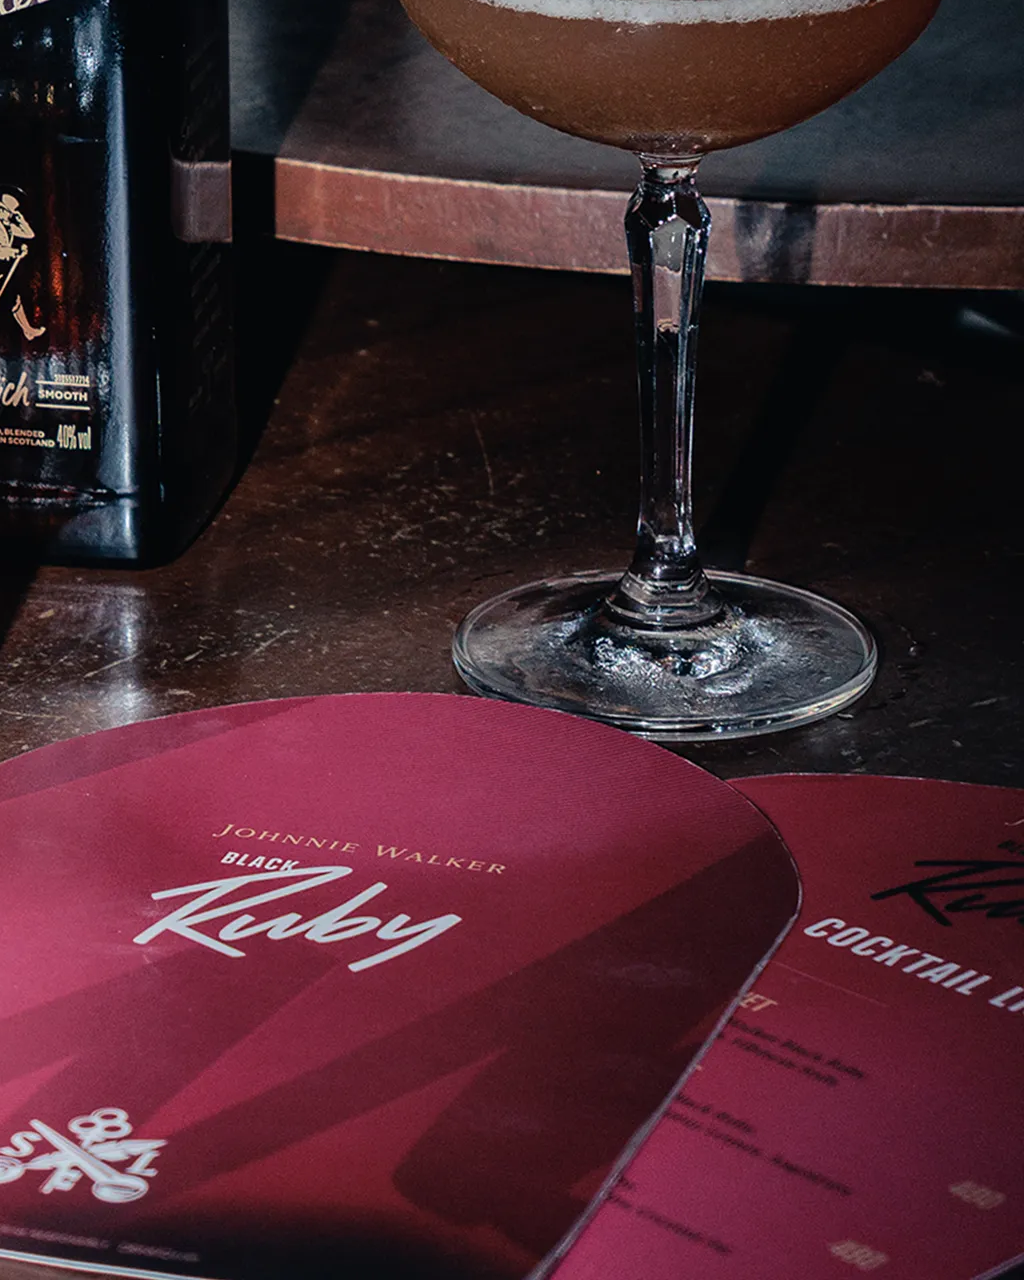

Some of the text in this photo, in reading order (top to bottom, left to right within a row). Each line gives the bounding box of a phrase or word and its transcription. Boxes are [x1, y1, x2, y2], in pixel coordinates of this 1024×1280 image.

[38, 389, 88, 402] SMOOTH
[4, 427, 45, 438] BLENDED
[8, 437, 55, 448] SCOTLAND
[56, 424, 91, 450] 40% vol
[212, 823, 507, 876] JOHNNIE WALKER
[220, 851, 299, 872] BLACK
[132, 865, 463, 972] Ruby
[803, 917, 992, 997] COCKTAIL
